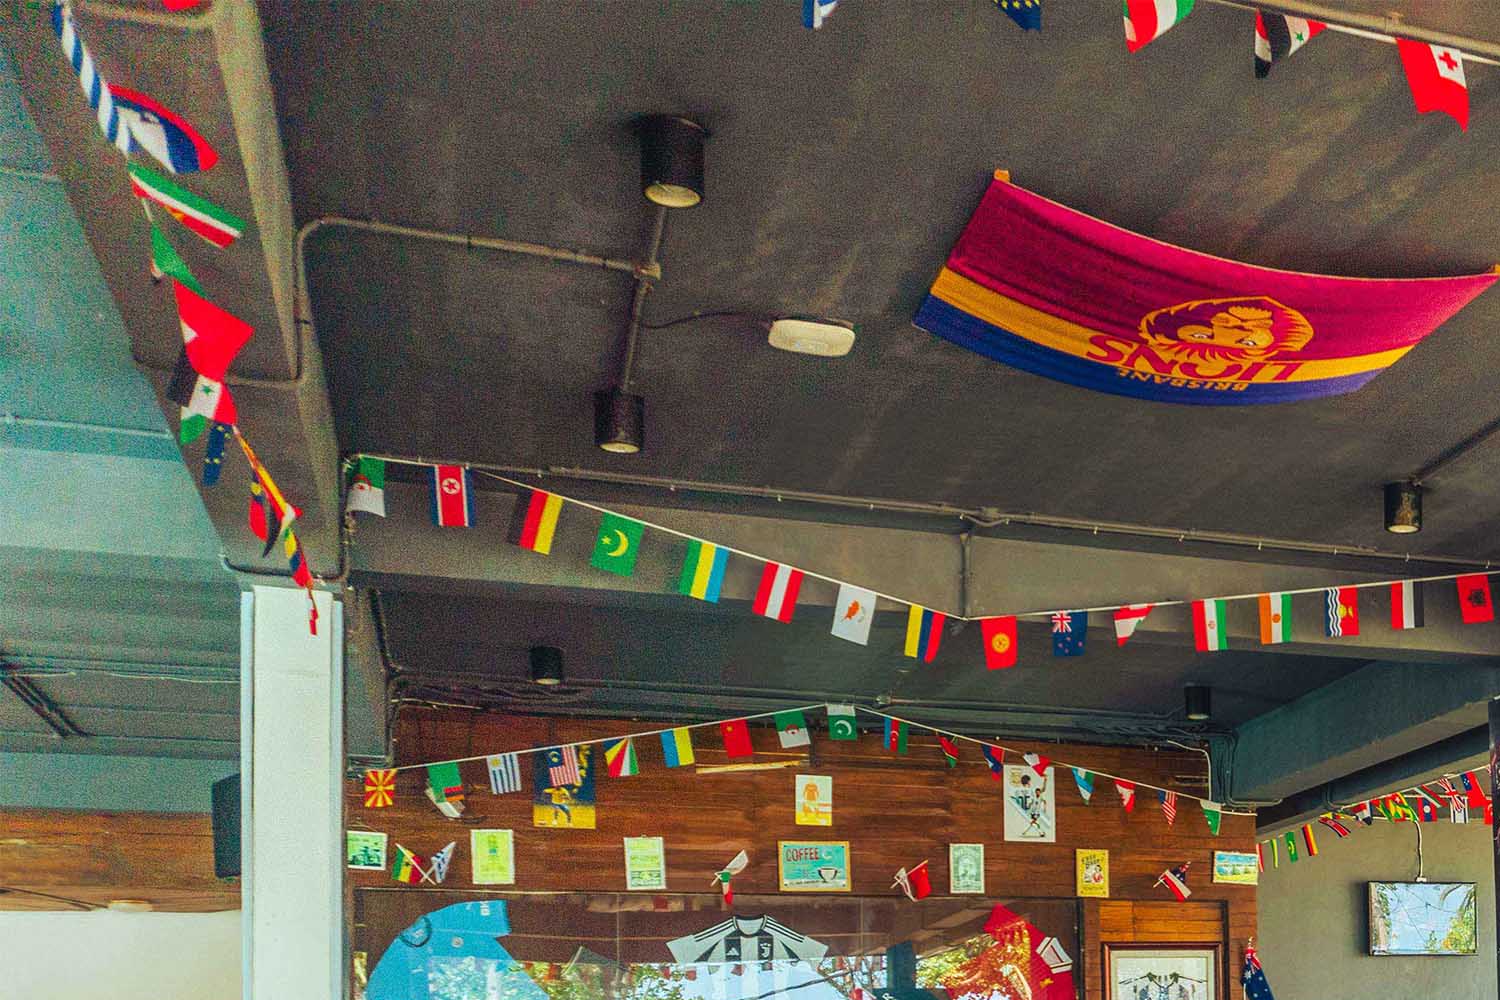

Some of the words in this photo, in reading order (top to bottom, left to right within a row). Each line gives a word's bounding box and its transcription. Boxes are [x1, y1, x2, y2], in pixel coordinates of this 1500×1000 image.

[1086, 334, 1304, 381] LIONS
[1118, 369, 1248, 392] BRISBANE
[786, 848, 820, 862] COFFEE
